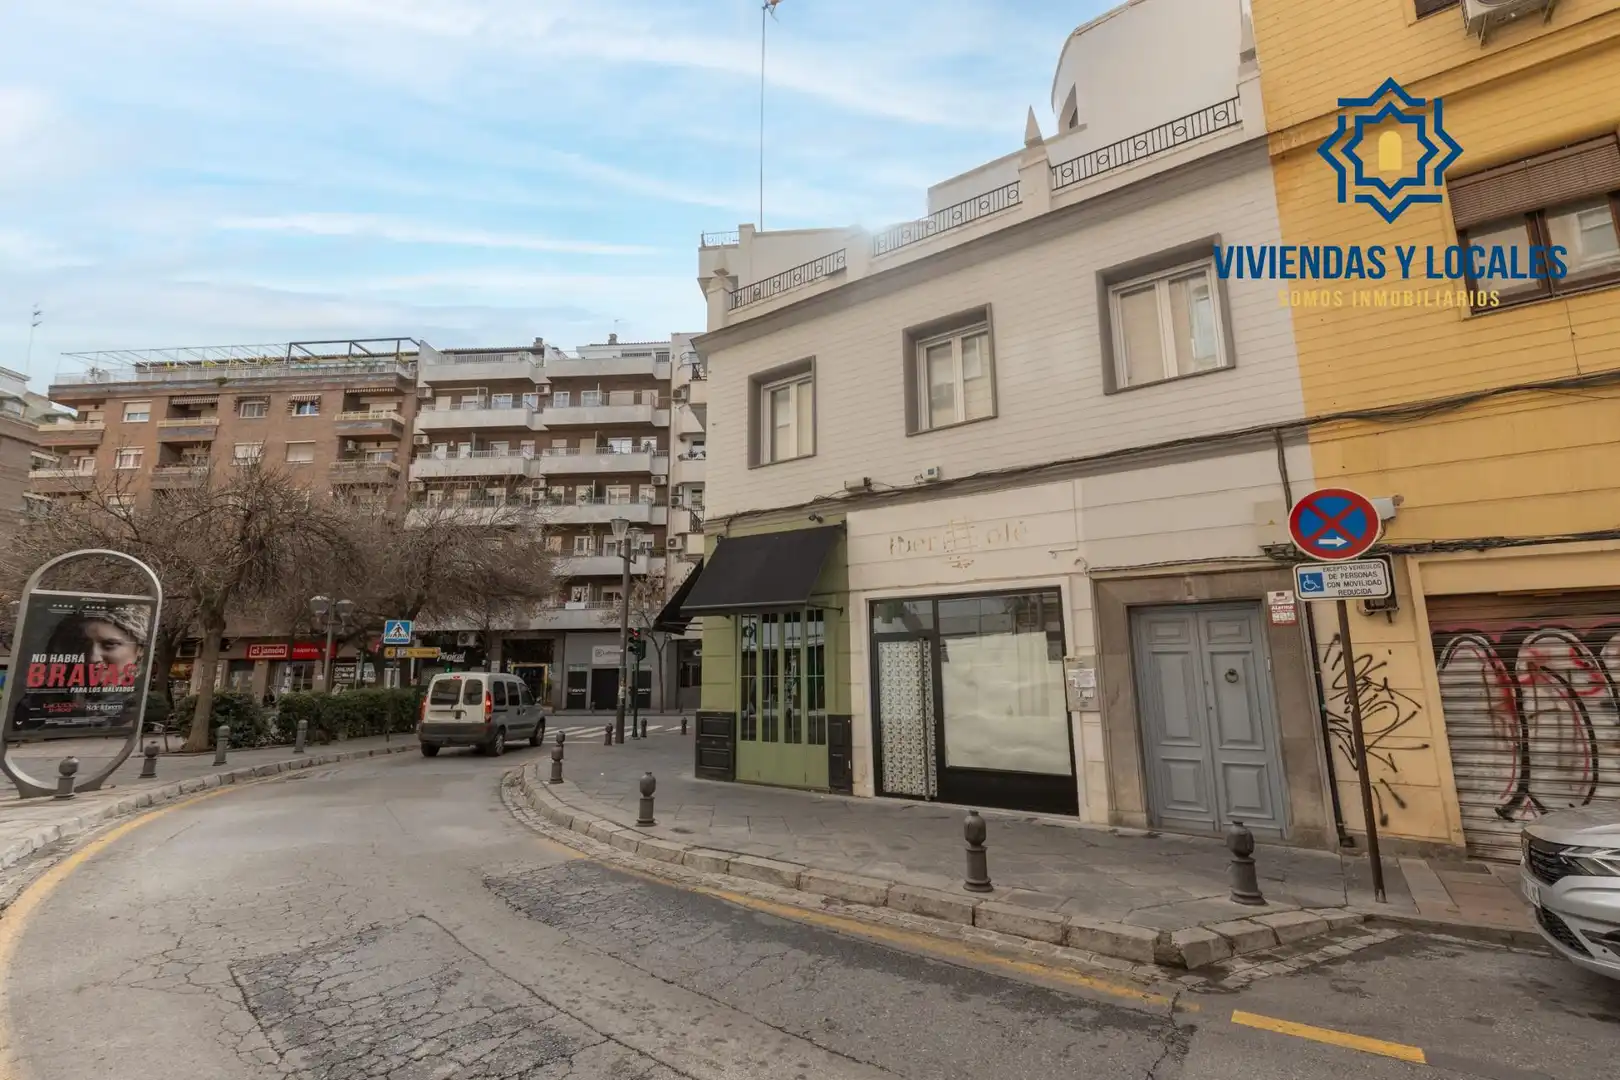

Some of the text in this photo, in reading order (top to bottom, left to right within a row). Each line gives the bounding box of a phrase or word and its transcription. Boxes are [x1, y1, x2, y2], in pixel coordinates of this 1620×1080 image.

[1340, 571, 1378, 579] PERSONAS
[1343, 579, 1383, 587] MOVILIDAD
[1338, 588, 1373, 596] REDUCIDA
[32, 652, 85, 663] NO HABRÁ
[26, 663, 137, 688] BRAVAS
